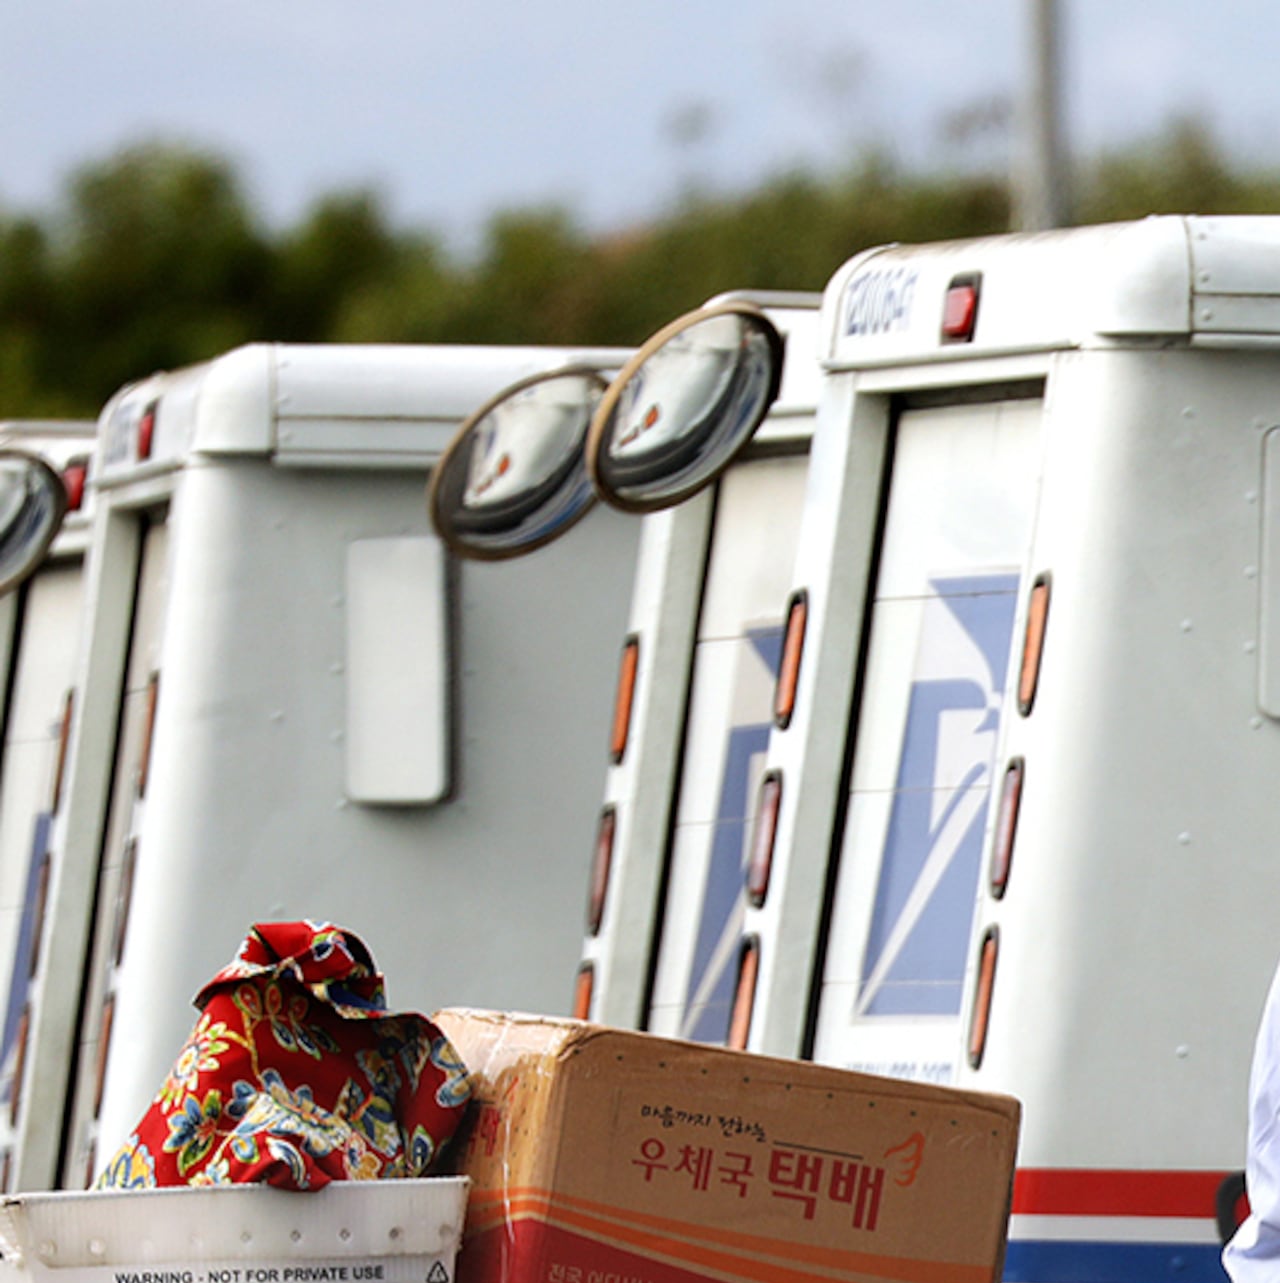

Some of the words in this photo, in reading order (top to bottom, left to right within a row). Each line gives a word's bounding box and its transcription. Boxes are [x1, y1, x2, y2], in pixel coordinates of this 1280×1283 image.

[640, 1103, 712, 1128] 마음까지
[631, 1137, 754, 1199] 우체국
[768, 1148, 885, 1232] 택배
[245, 1268, 279, 1283] FOR
[282, 1266, 350, 1282] PRIVATE
[352, 1265, 385, 1281] USE
